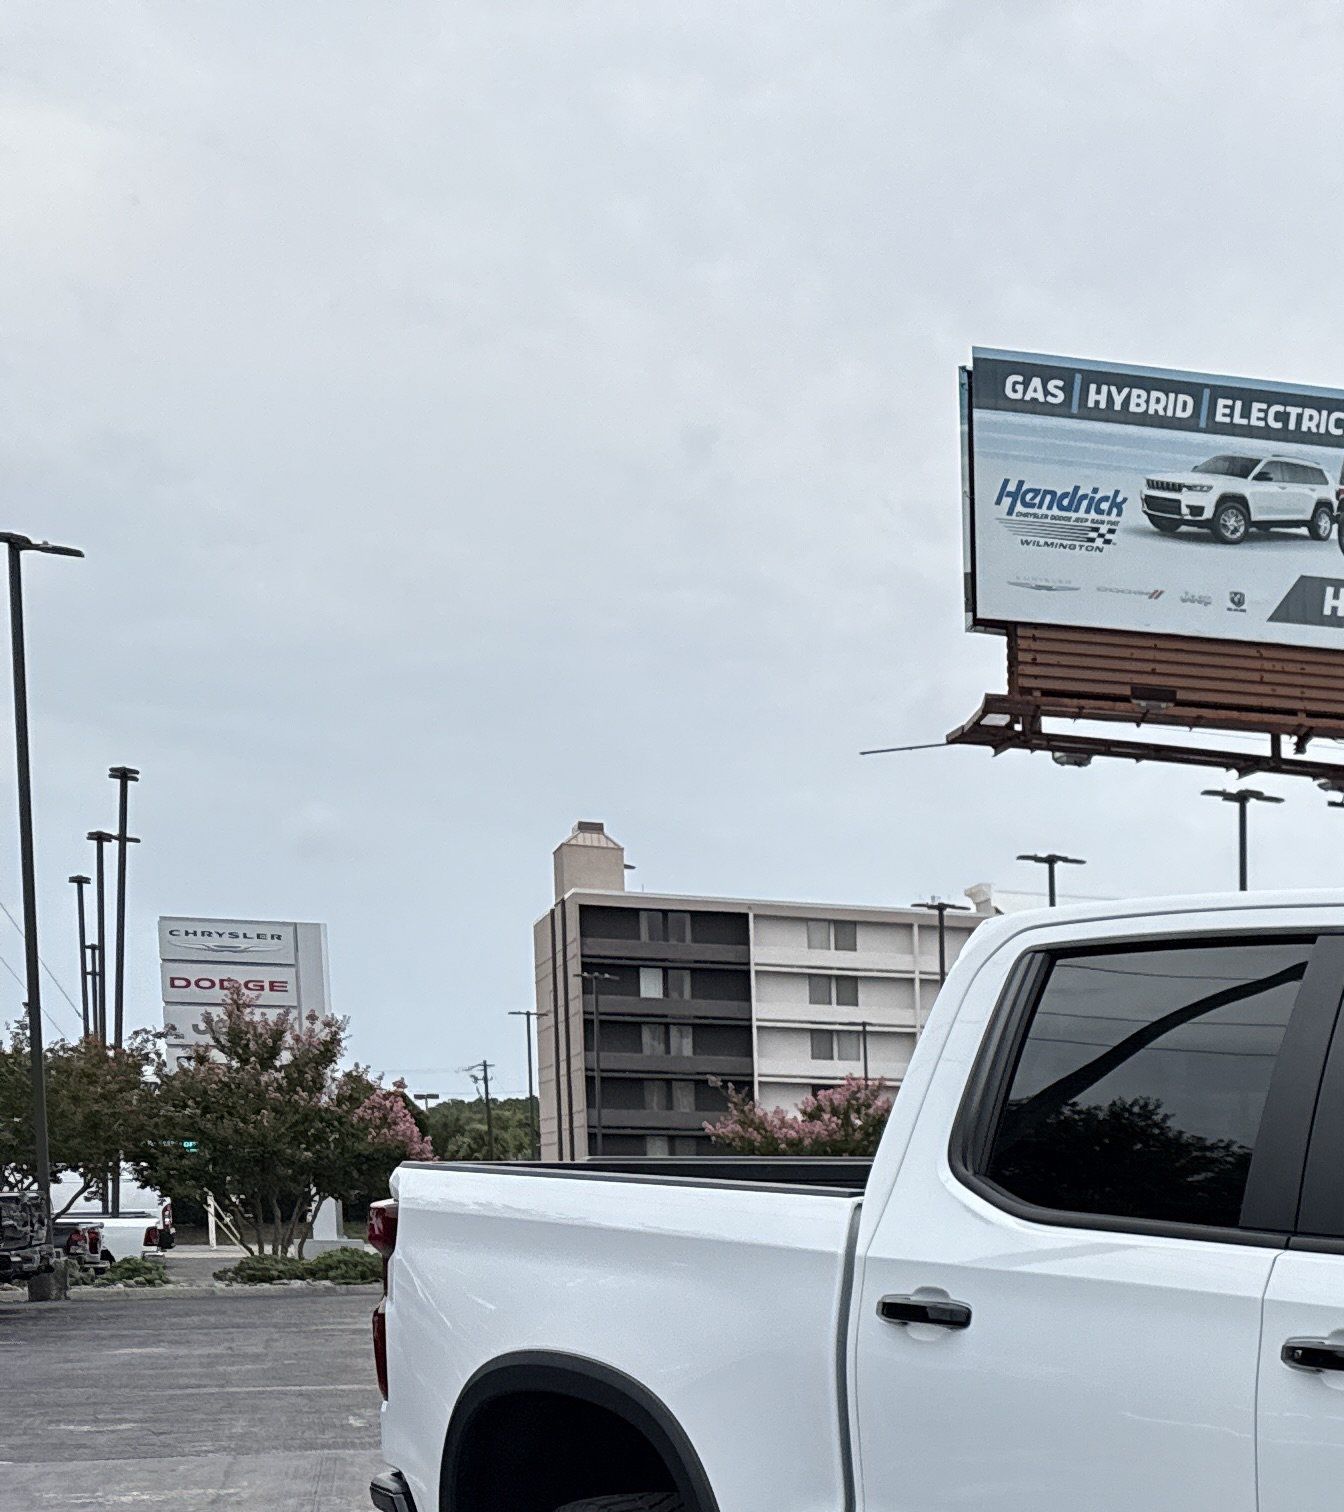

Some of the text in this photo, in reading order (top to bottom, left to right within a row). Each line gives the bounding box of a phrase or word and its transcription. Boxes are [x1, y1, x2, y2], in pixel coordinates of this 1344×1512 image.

[1005, 374, 1066, 404] GAS
[1087, 384, 1194, 419] HYBRID
[995, 478, 1128, 517] Hendrick
[1020, 538, 1104, 553] WILMINGTON
[168, 929, 283, 941] CHRYSLER
[169, 976, 289, 993] DODGE
